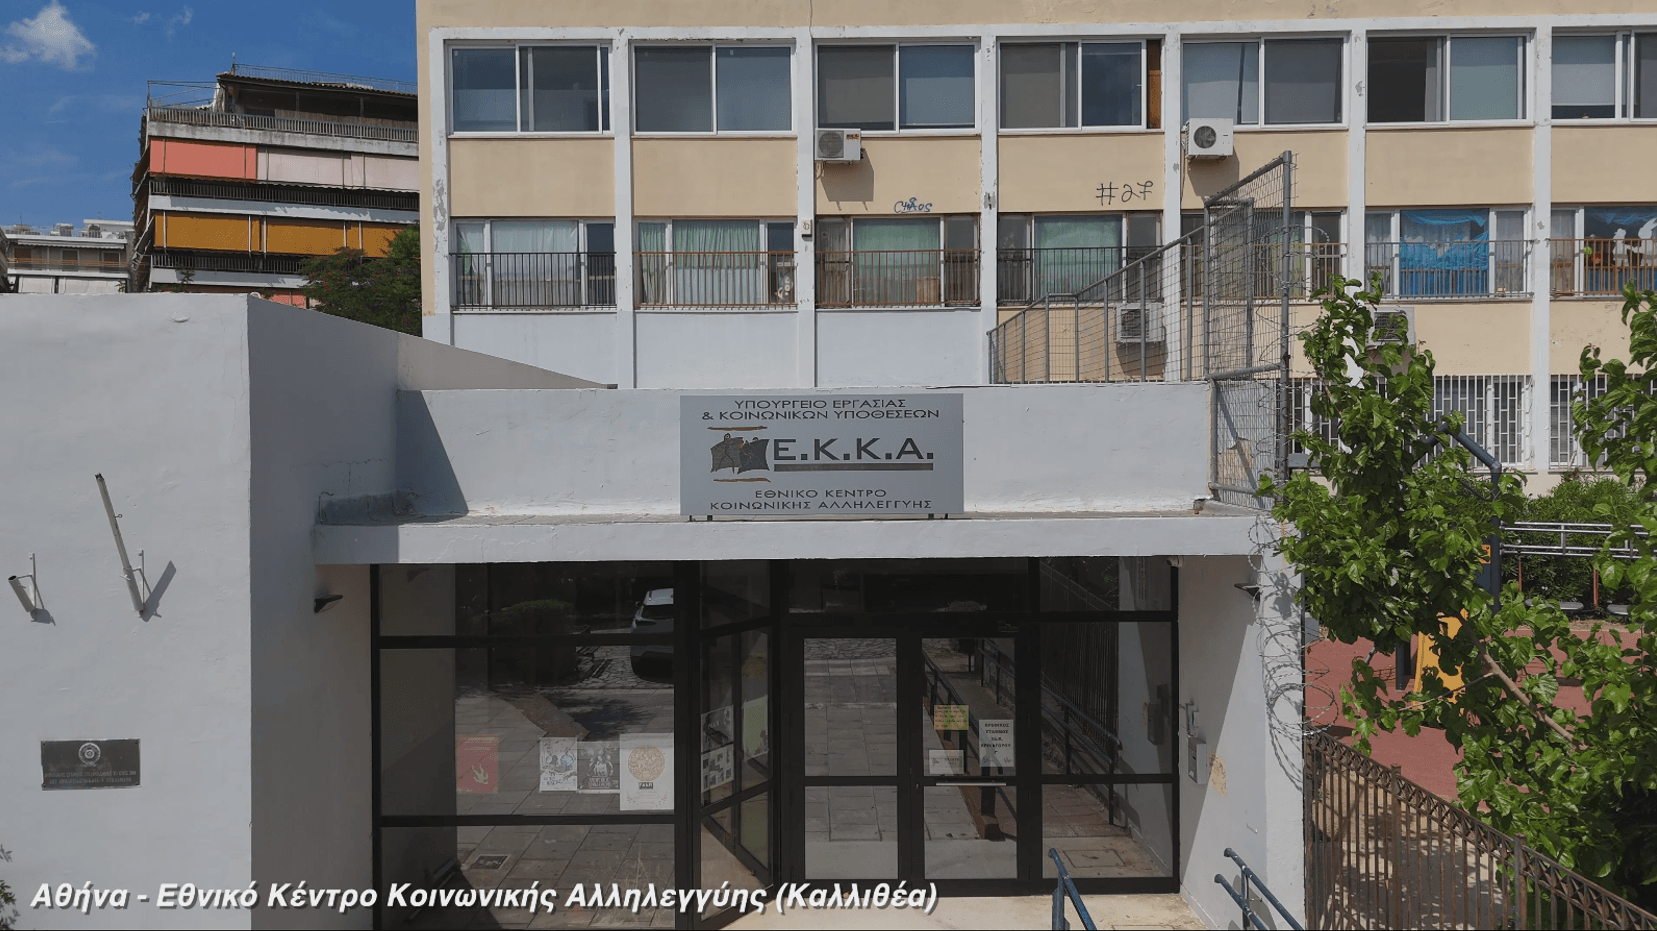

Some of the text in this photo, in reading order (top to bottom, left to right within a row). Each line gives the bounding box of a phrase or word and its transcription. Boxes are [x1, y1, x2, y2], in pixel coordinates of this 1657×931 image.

[734, 398, 906, 409] ΥΠΟΥΡΓΕΙΟ ΕΡΓΑΣΙΑΣ
[701, 409, 940, 420] & ΚΟΙΝΩΝΙΚΩΝ ΥΠΟΘΕΣΕΩΝ
[773, 437, 934, 461] Ε.Κ.Κ.Α.
[755, 489, 887, 498] ΕΘΝΙΚΟ ΚΕΝΤΡΟ
[710, 500, 932, 510] ΚΟΙΝΩΝΙΚΗΣ ΑΛΛΗΛΕΓΓΥΗΣ
